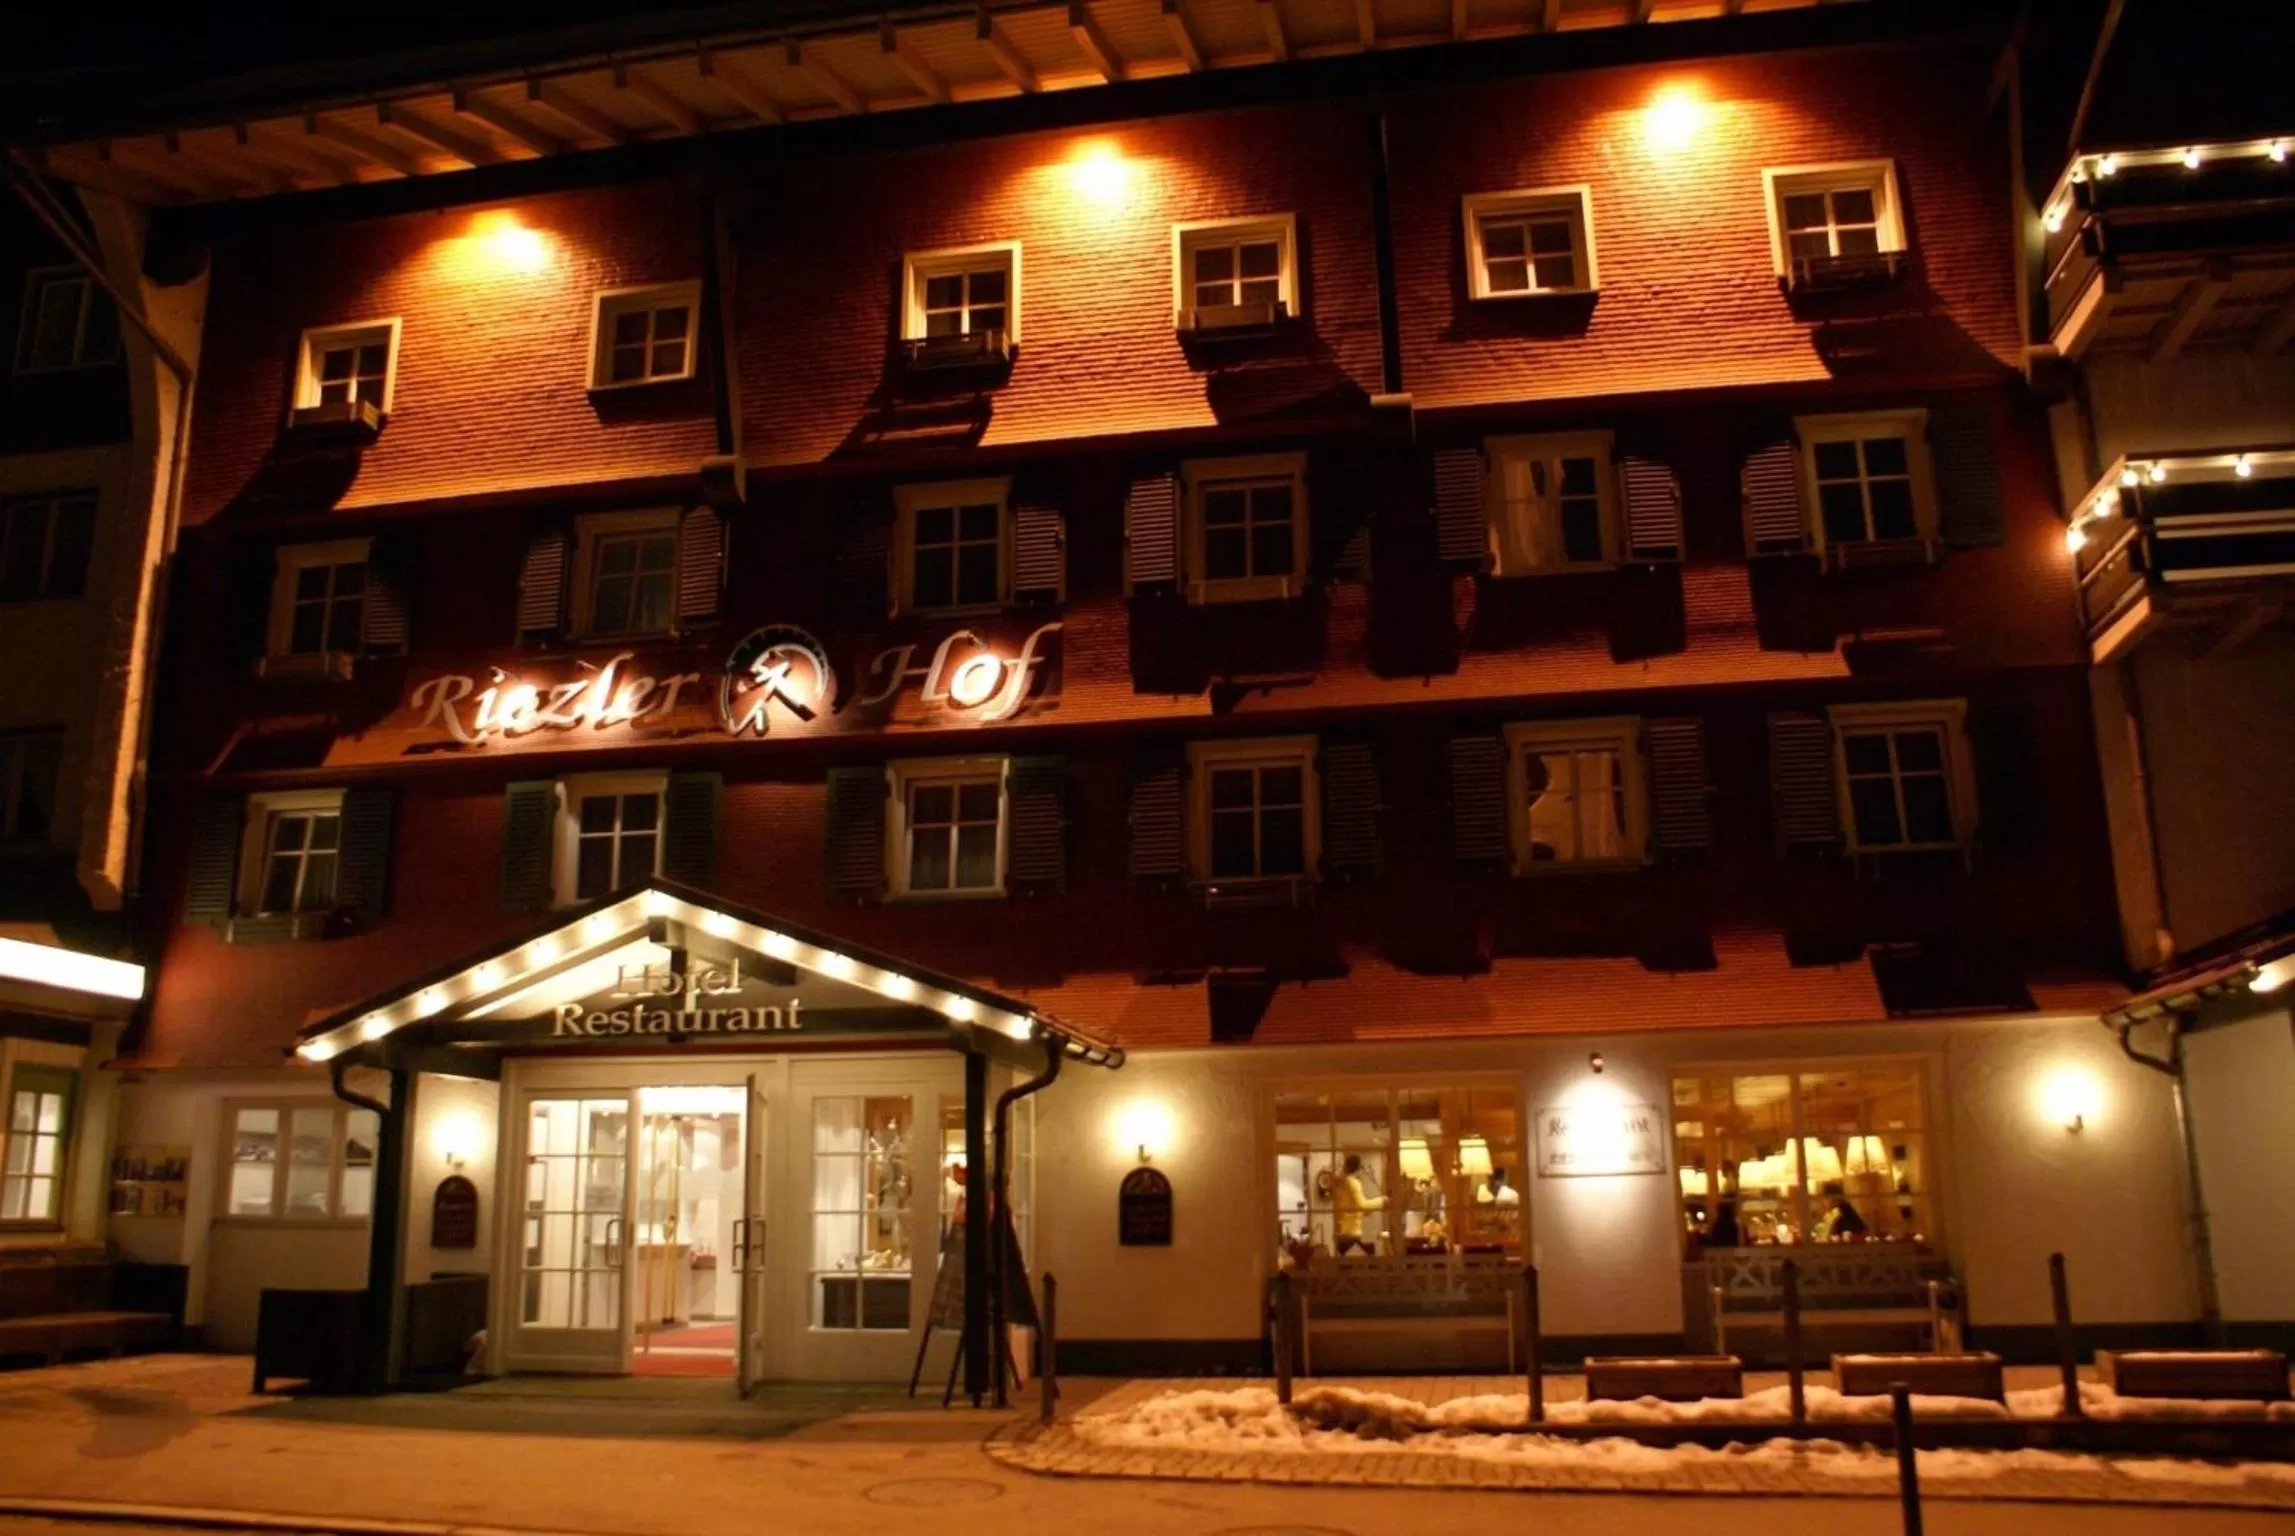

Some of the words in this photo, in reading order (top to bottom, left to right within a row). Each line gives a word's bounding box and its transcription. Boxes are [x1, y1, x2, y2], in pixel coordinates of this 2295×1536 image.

[861, 622, 1064, 721] Hof
[612, 957, 743, 999] Hotel
[552, 998, 803, 1037] Restaurant
